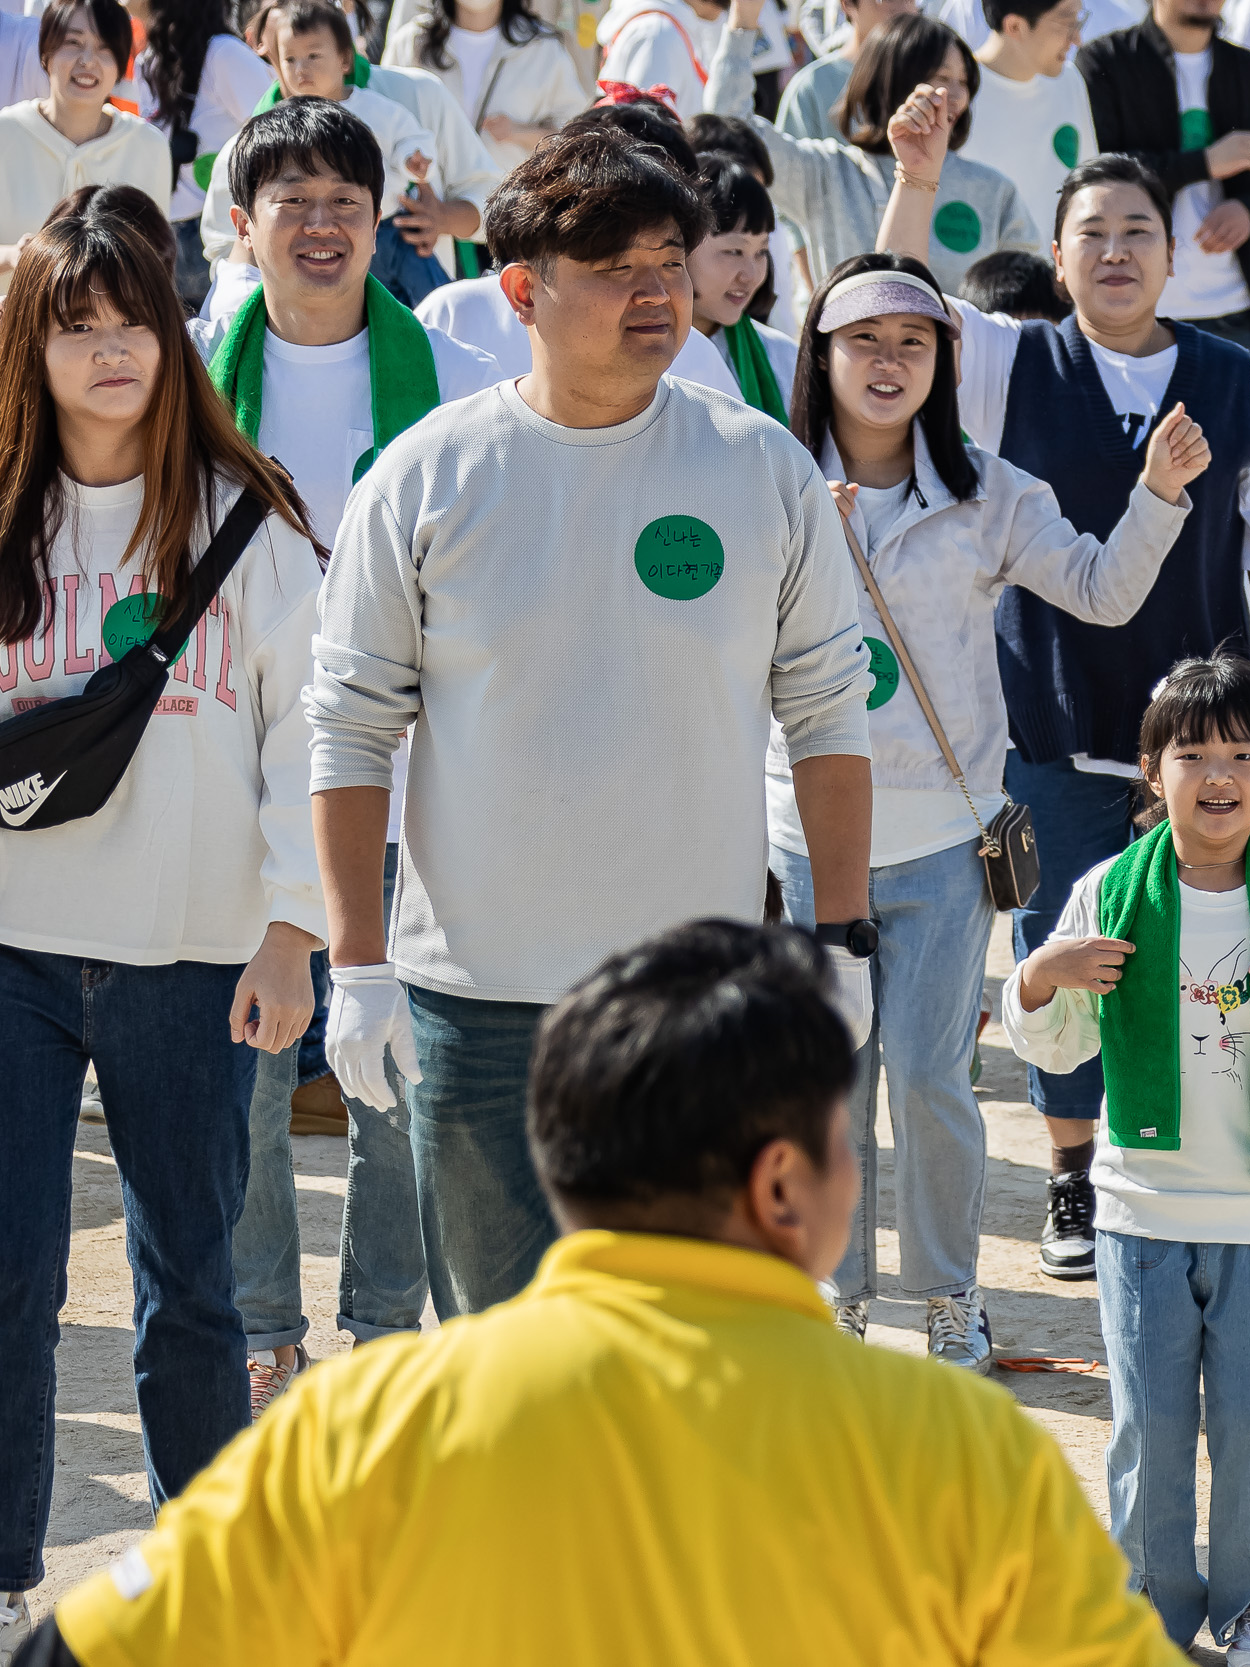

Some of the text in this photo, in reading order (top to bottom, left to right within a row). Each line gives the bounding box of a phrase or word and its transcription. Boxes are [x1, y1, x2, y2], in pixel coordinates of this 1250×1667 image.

[654, 524, 702, 548] 신나는
[155, 698, 195, 713] PLACE
[0, 772, 48, 811] NIKE
